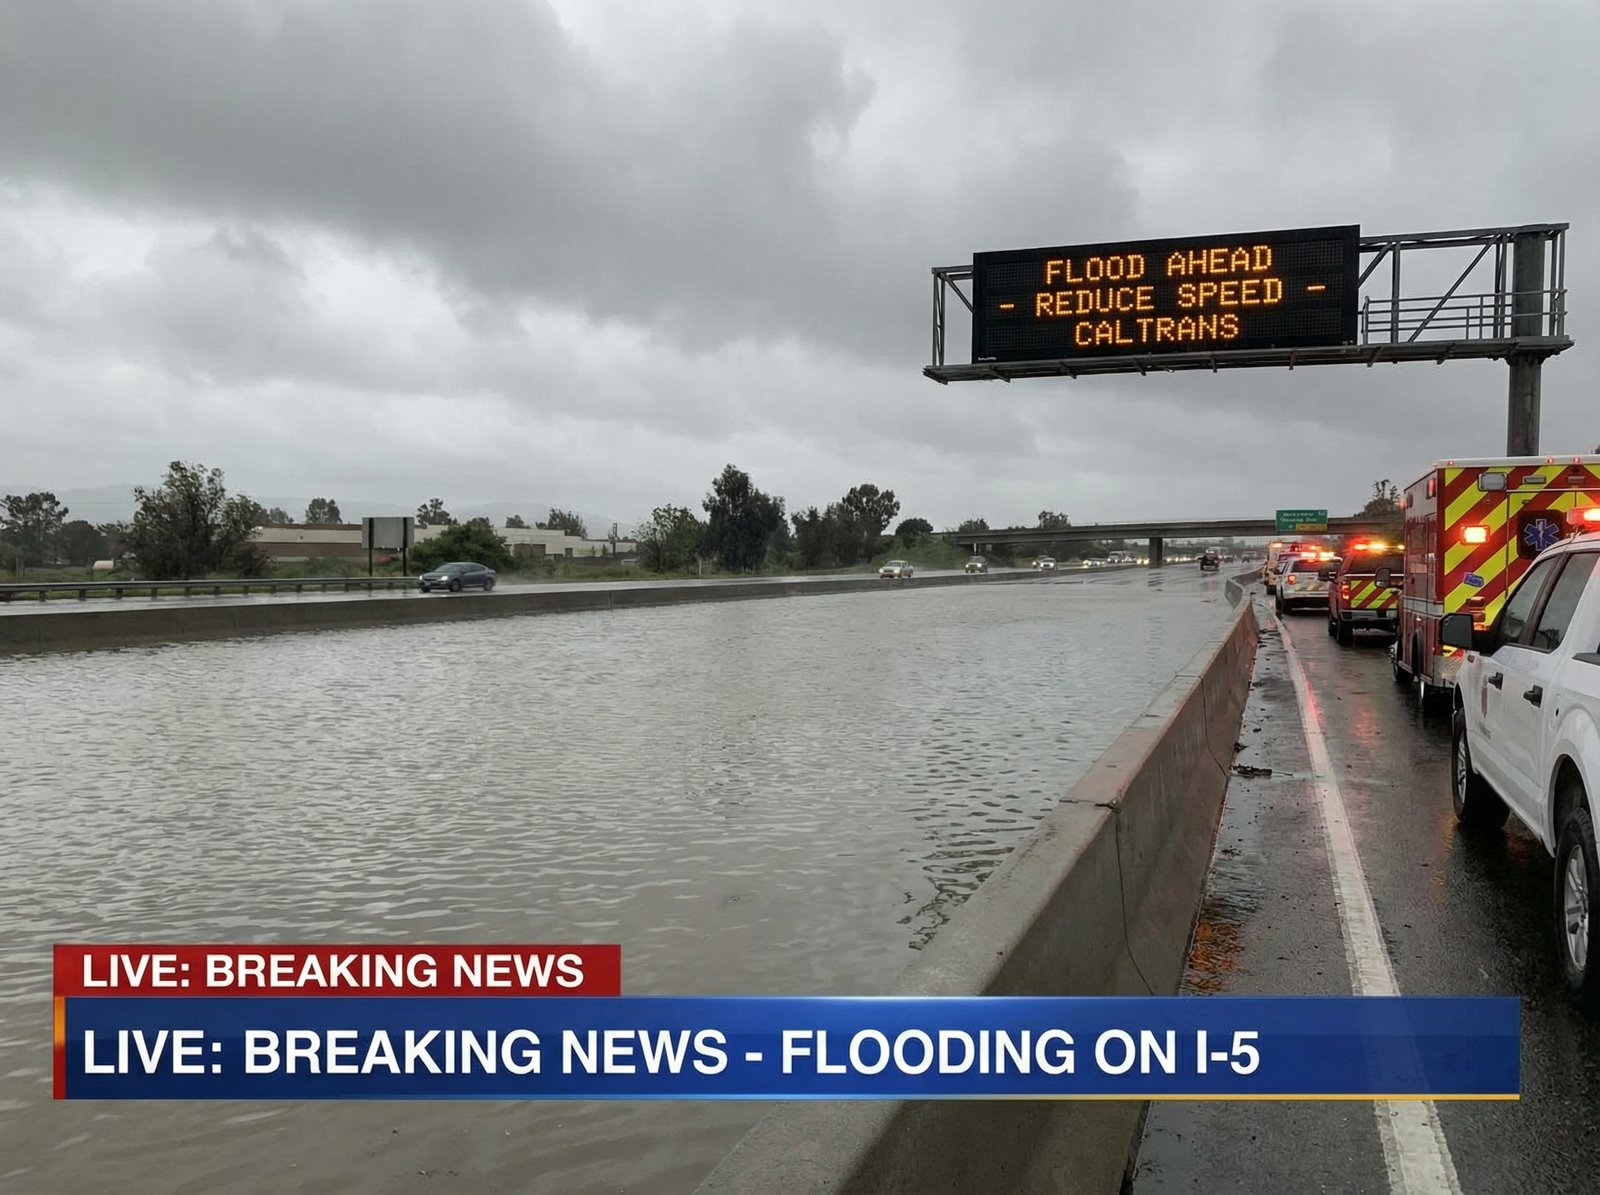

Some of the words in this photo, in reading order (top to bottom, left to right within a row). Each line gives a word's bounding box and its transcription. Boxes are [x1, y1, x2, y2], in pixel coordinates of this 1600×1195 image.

[1046, 254, 1145, 285] FLOOD
[1167, 245, 1272, 277] AHEAD
[1036, 286, 1154, 317] REDUCE
[1177, 277, 1283, 308] SPEED
[1075, 313, 1239, 346] CALTRANS
